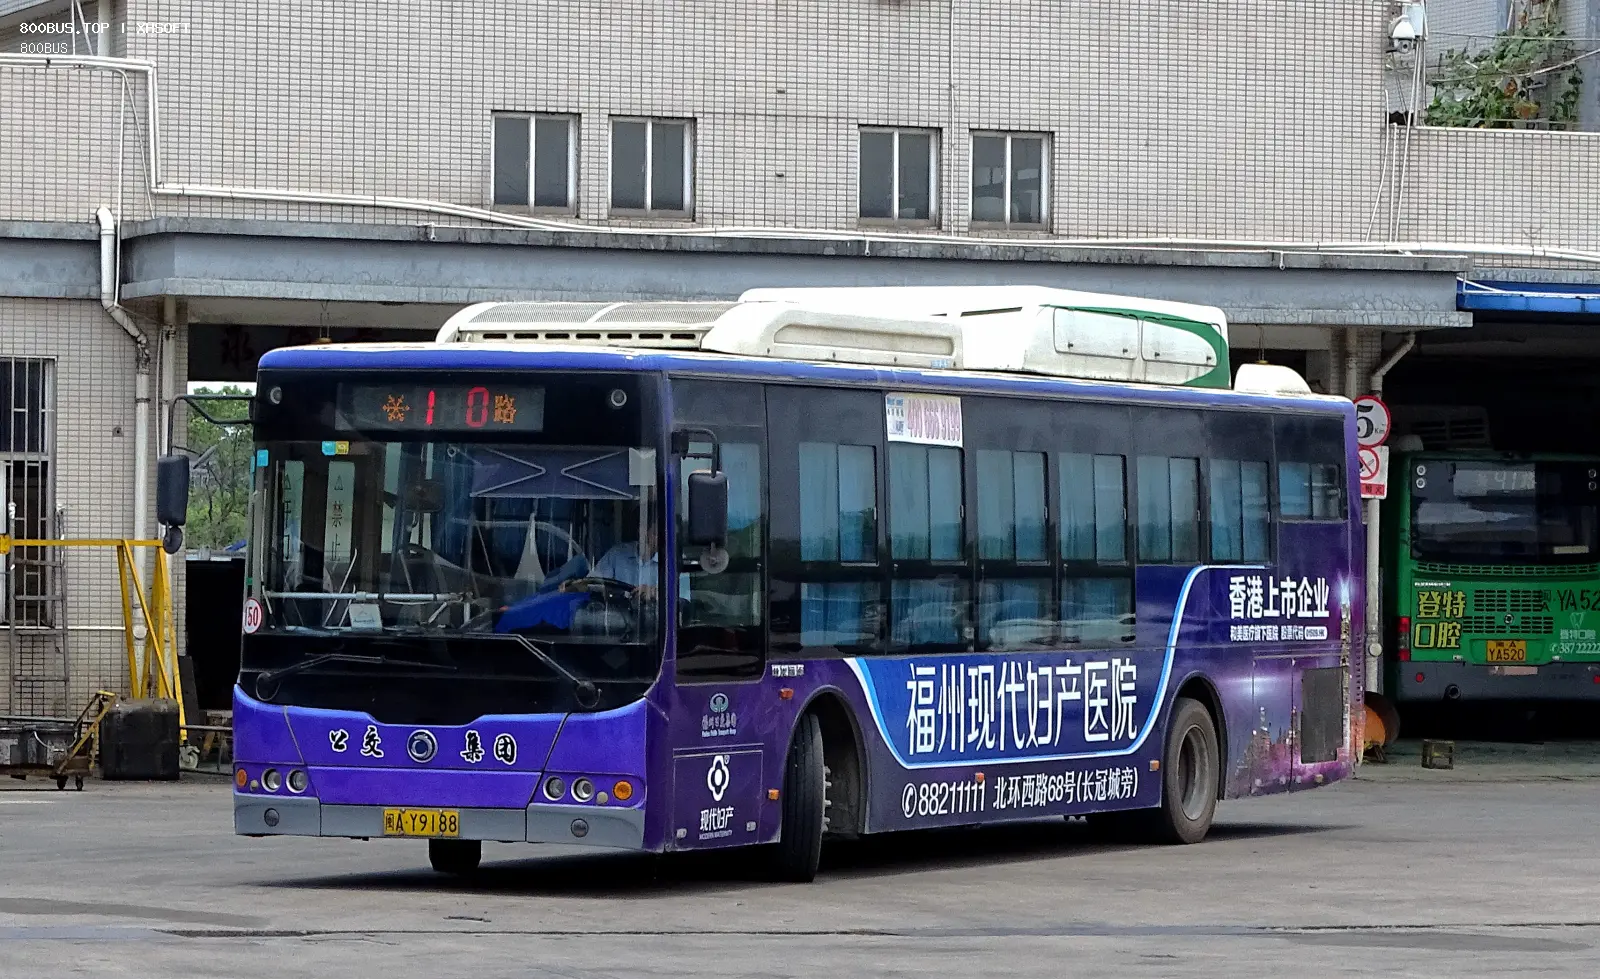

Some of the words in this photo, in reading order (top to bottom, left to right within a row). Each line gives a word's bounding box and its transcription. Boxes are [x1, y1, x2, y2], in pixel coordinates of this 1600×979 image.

[1357, 404, 1374, 439] 5
[1229, 575, 1330, 619] 香港上市企业
[1417, 590, 1466, 618] 登特
[1414, 622, 1461, 648] 口腔
[1489, 649, 1525, 661] YA520
[906, 657, 1138, 756] 福州现代妇产医院
[992, 766, 1139, 810] 北环西路68号(长冠城旁)
[700, 806, 734, 831] 现代妇产
